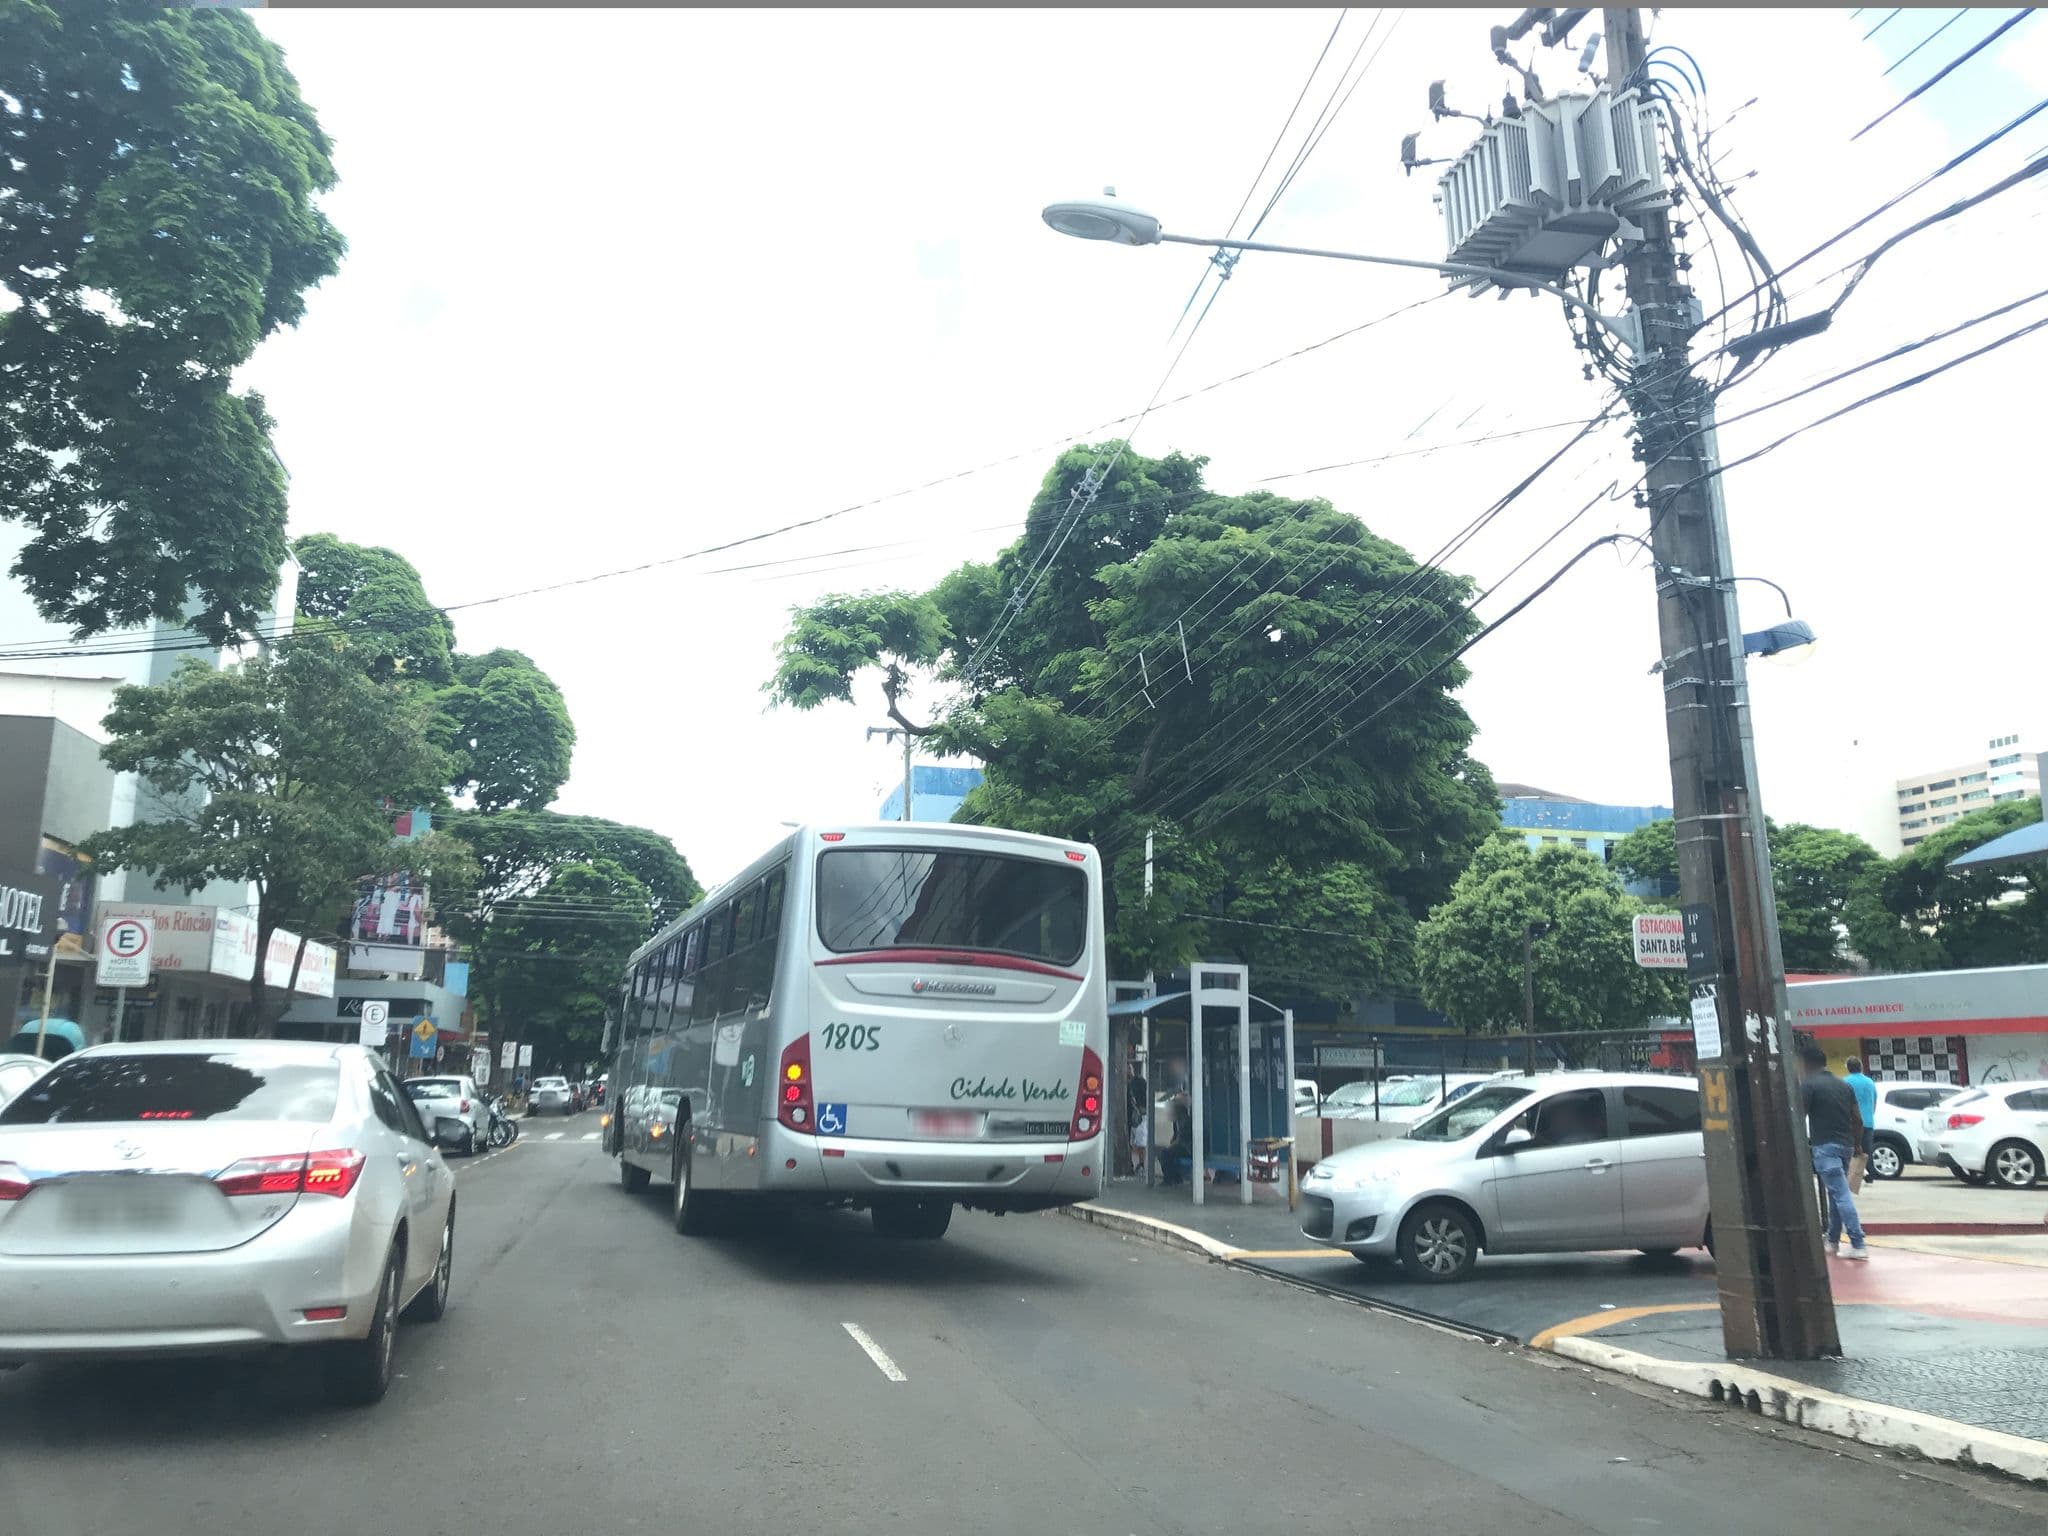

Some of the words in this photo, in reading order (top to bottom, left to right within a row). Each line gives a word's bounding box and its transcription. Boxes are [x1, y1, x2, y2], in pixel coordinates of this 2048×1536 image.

[1640, 919, 1683, 934] ESTACIONA
[119, 929, 136, 949] E
[1640, 938, 1668, 953] SANTA
[370, 1008, 379, 1021] E
[1805, 1008, 1823, 1017] SUA
[1865, 1003, 1905, 1015] MERECE
[822, 1022, 881, 1050] 1805
[950, 1076, 1016, 1100] Cidade
[1022, 1078, 1069, 1102] Verde
